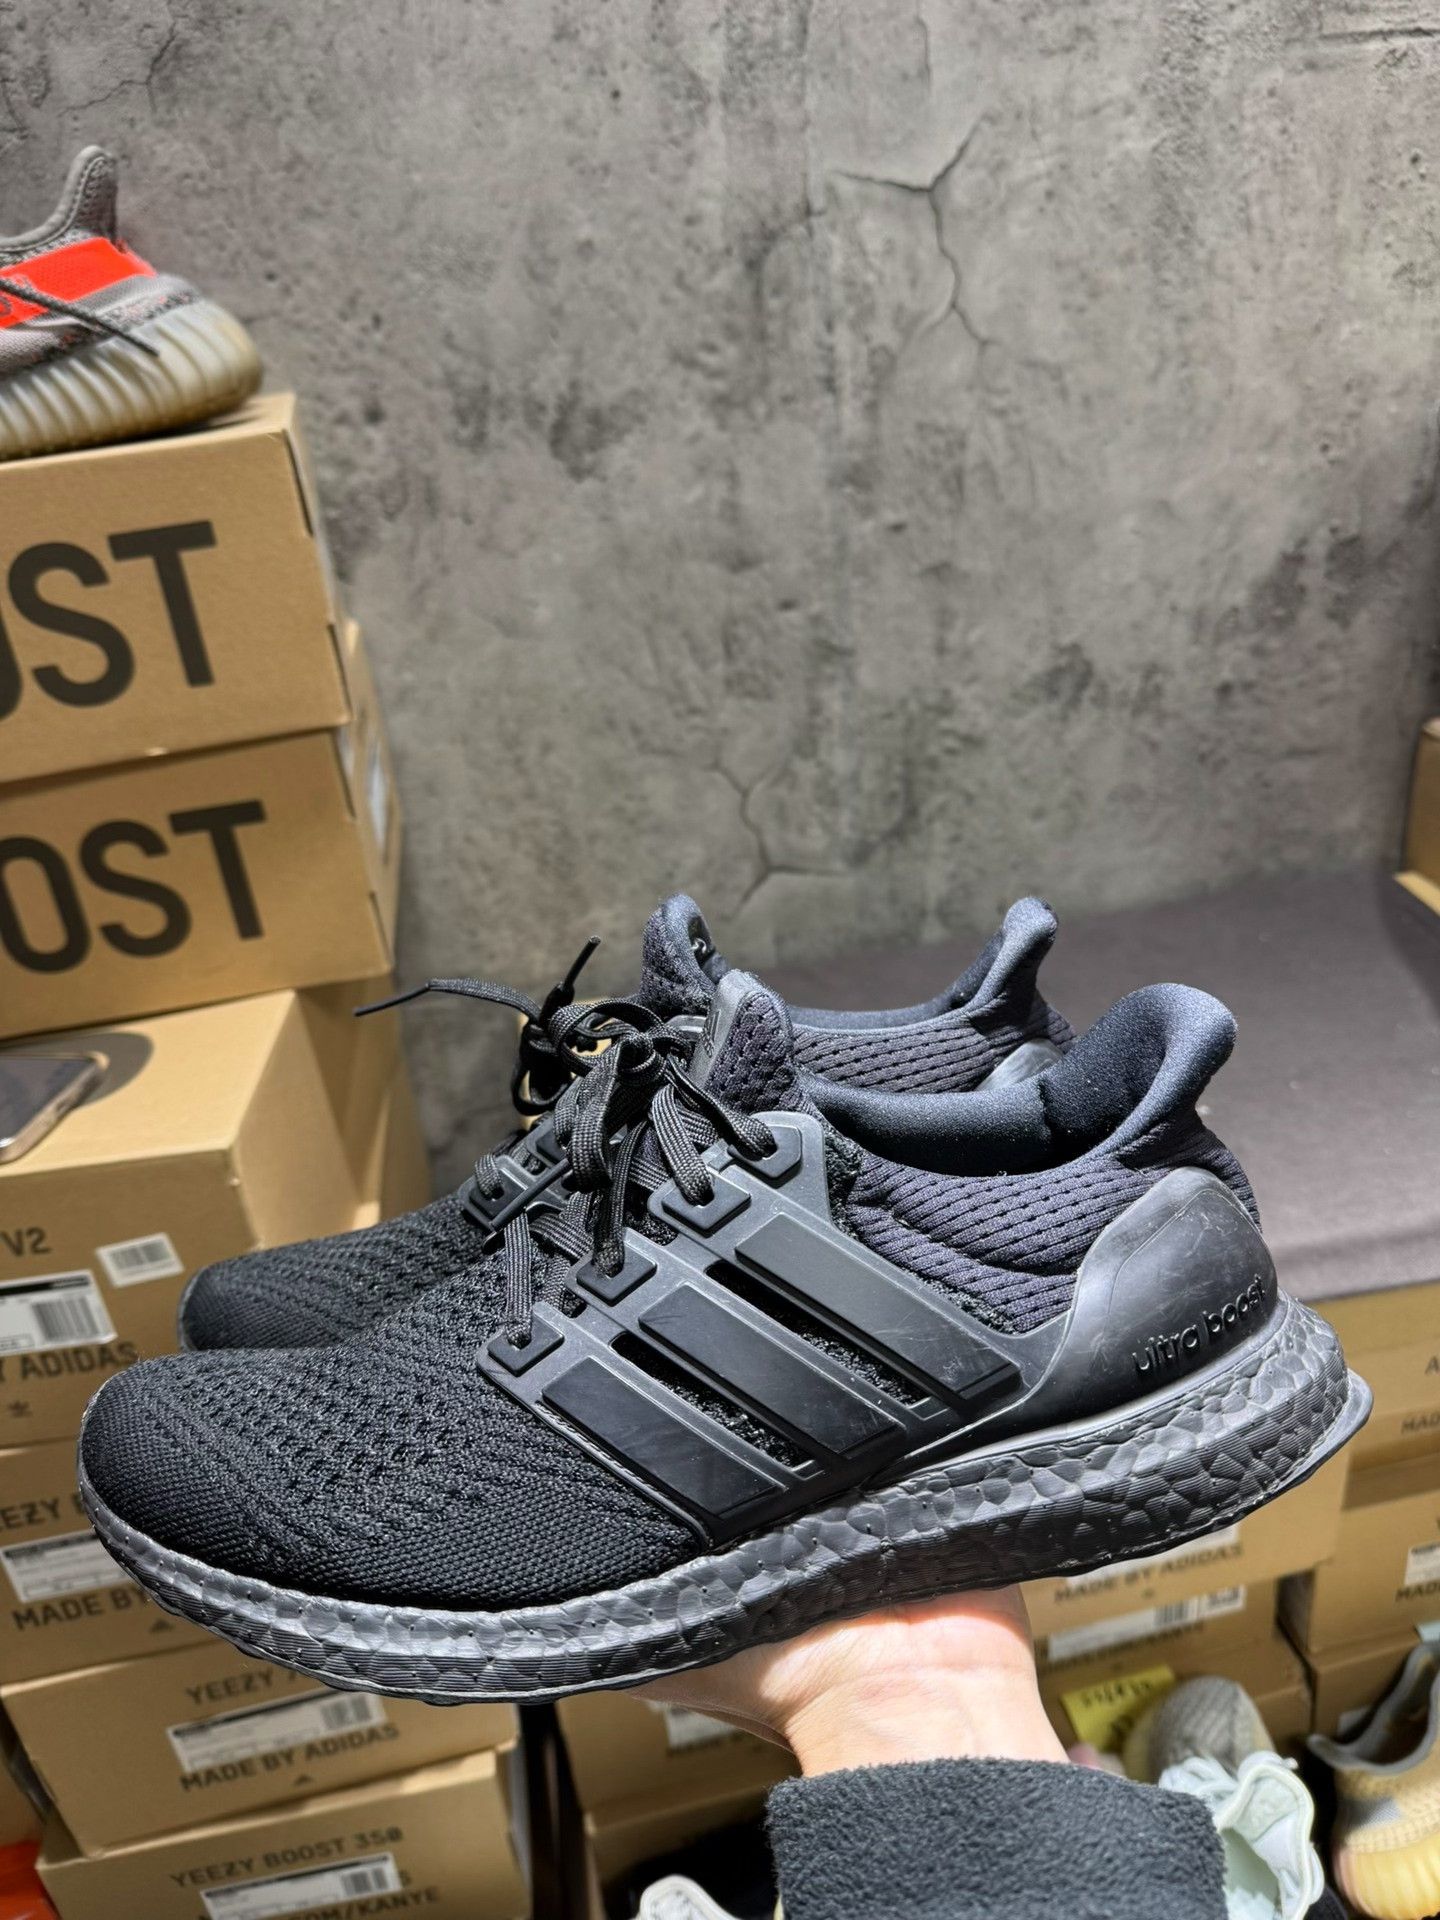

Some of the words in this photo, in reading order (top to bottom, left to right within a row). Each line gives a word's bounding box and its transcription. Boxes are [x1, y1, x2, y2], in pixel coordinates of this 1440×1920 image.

[0, 519, 217, 723] ST
[0, 799, 266, 974] OST
[0, 1227, 52, 1256] V2
[20, 1341, 138, 1381] ADIDAS
[0, 1497, 61, 1532] EZY
[11, 1593, 104, 1630] MADE
[186, 1668, 273, 1704] YEEZY
[179, 1757, 257, 1791] MADE
[260, 1749, 296, 1773] BY
[304, 1722, 400, 1761] ADIDAS
[170, 1856, 255, 1888] YEEZY
[262, 1837, 346, 1869] BOOST
[353, 1825, 403, 1849] 350
